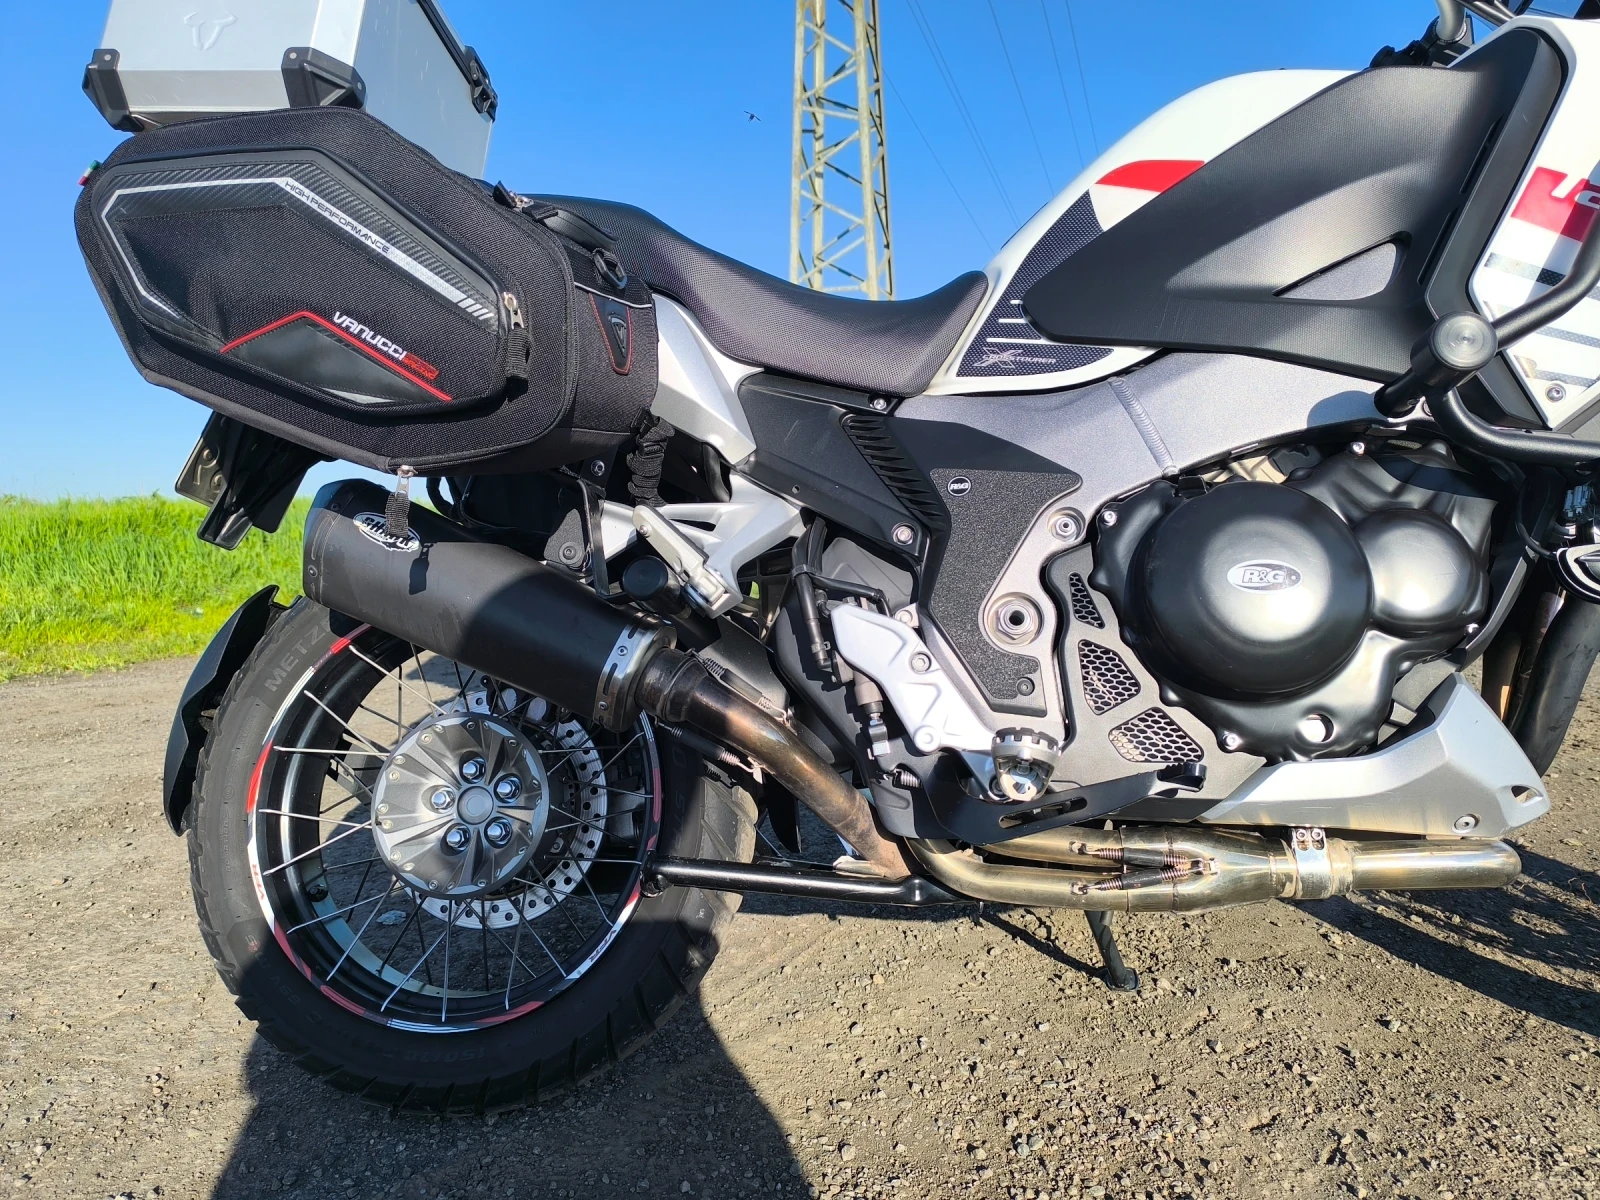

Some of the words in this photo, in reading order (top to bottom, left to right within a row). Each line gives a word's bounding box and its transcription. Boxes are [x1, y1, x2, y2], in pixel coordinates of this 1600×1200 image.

[284, 180, 311, 201] HIGH
[310, 197, 390, 254] PERFORMANCE
[333, 311, 407, 361] VANUCCI
[1242, 569, 1286, 584] R&G
